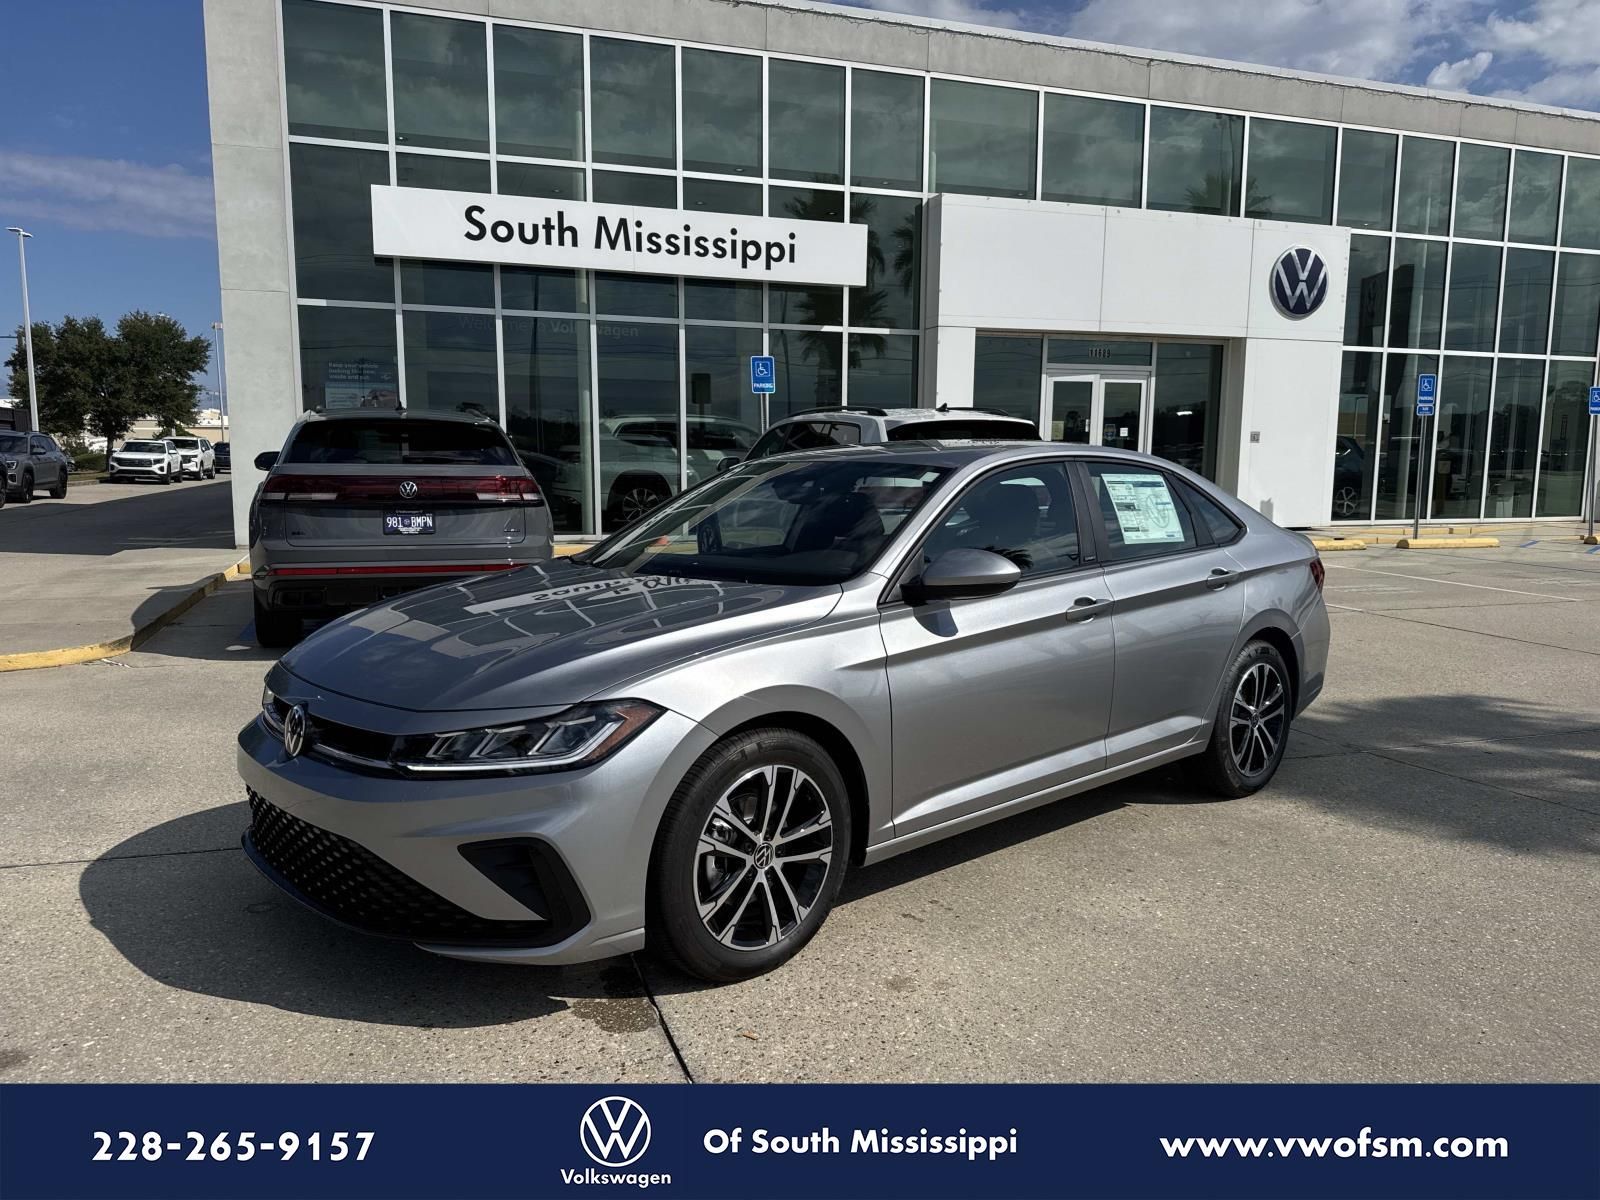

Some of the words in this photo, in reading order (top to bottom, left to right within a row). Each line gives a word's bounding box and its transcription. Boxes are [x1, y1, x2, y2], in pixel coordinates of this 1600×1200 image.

[463, 204, 579, 248] South
[594, 214, 797, 270] Mississippi
[386, 516, 404, 528] 981
[410, 516, 433, 528] BMPN
